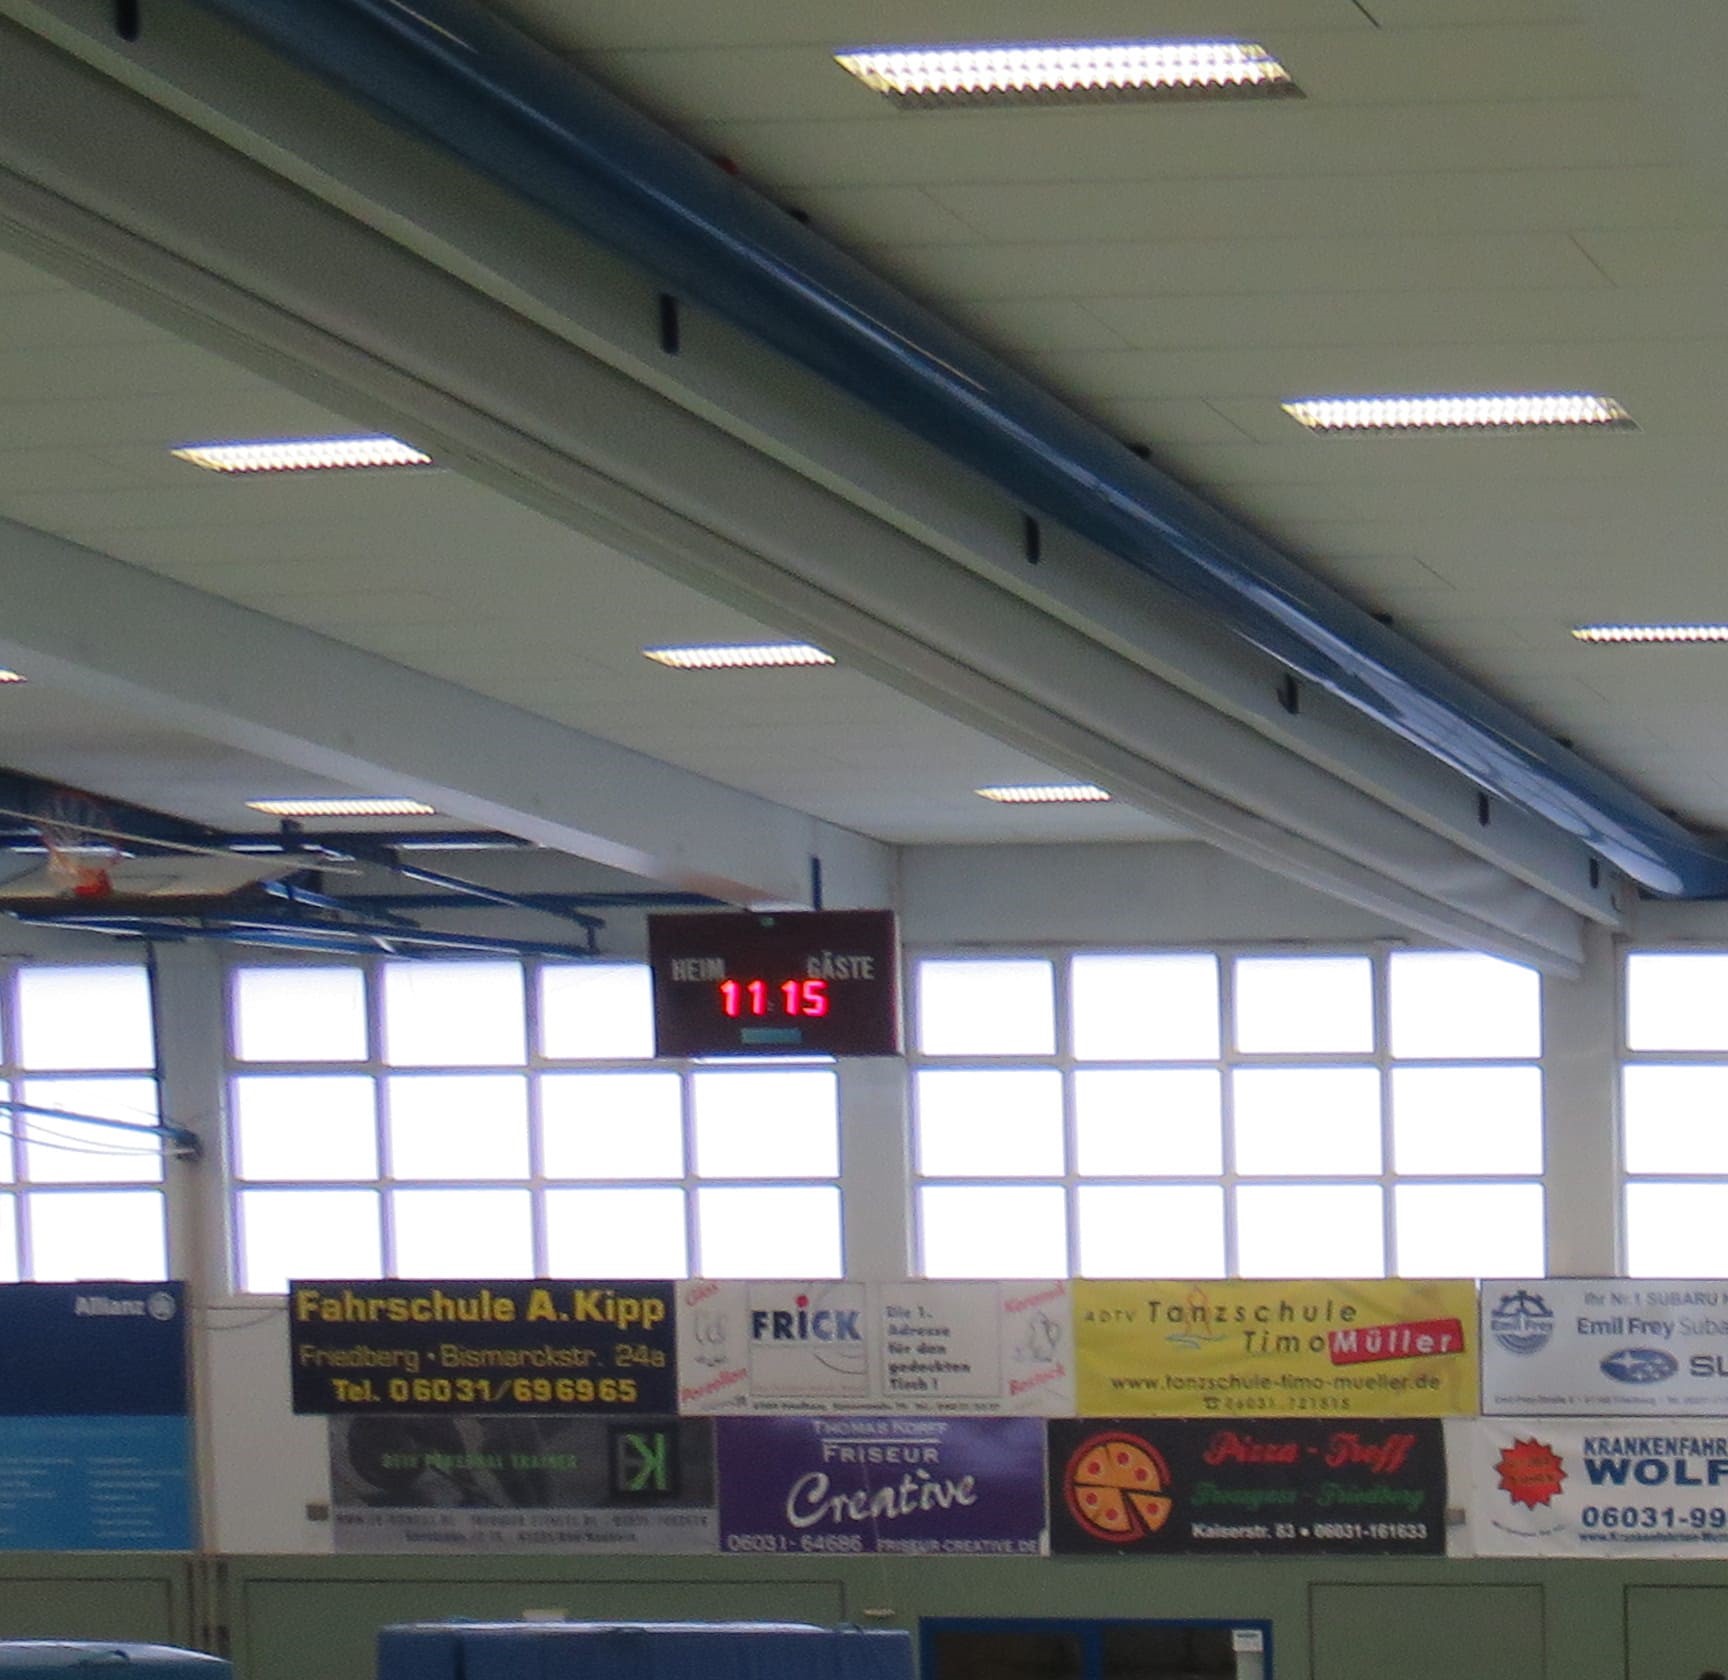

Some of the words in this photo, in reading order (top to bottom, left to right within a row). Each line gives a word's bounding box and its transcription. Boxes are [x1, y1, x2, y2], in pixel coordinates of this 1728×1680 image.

[671, 957, 726, 981] HEIM
[807, 951, 876, 980] GÄSTE
[299, 1290, 516, 1322] Fahrschule
[1584, 1292, 1606, 1306] Ihr
[1646, 1292, 1719, 1307] SUBARU
[1148, 1300, 1359, 1323] Tanzschule
[1243, 1330, 1327, 1353] Timo
[1332, 1327, 1454, 1354] Müller
[1577, 1317, 1624, 1336] Emil
[1627, 1317, 1675, 1341] Frey
[300, 1345, 420, 1372] Friedberg
[917, 1342, 947, 1355] den
[888, 1361, 971, 1376] gedeckten
[332, 1379, 380, 1402] Tel.
[1110, 1374, 1441, 1393] www.tanzschule-timo-mueller.de
[822, 1445, 941, 1465] FRISEUR
[786, 1468, 978, 1528] Creative
